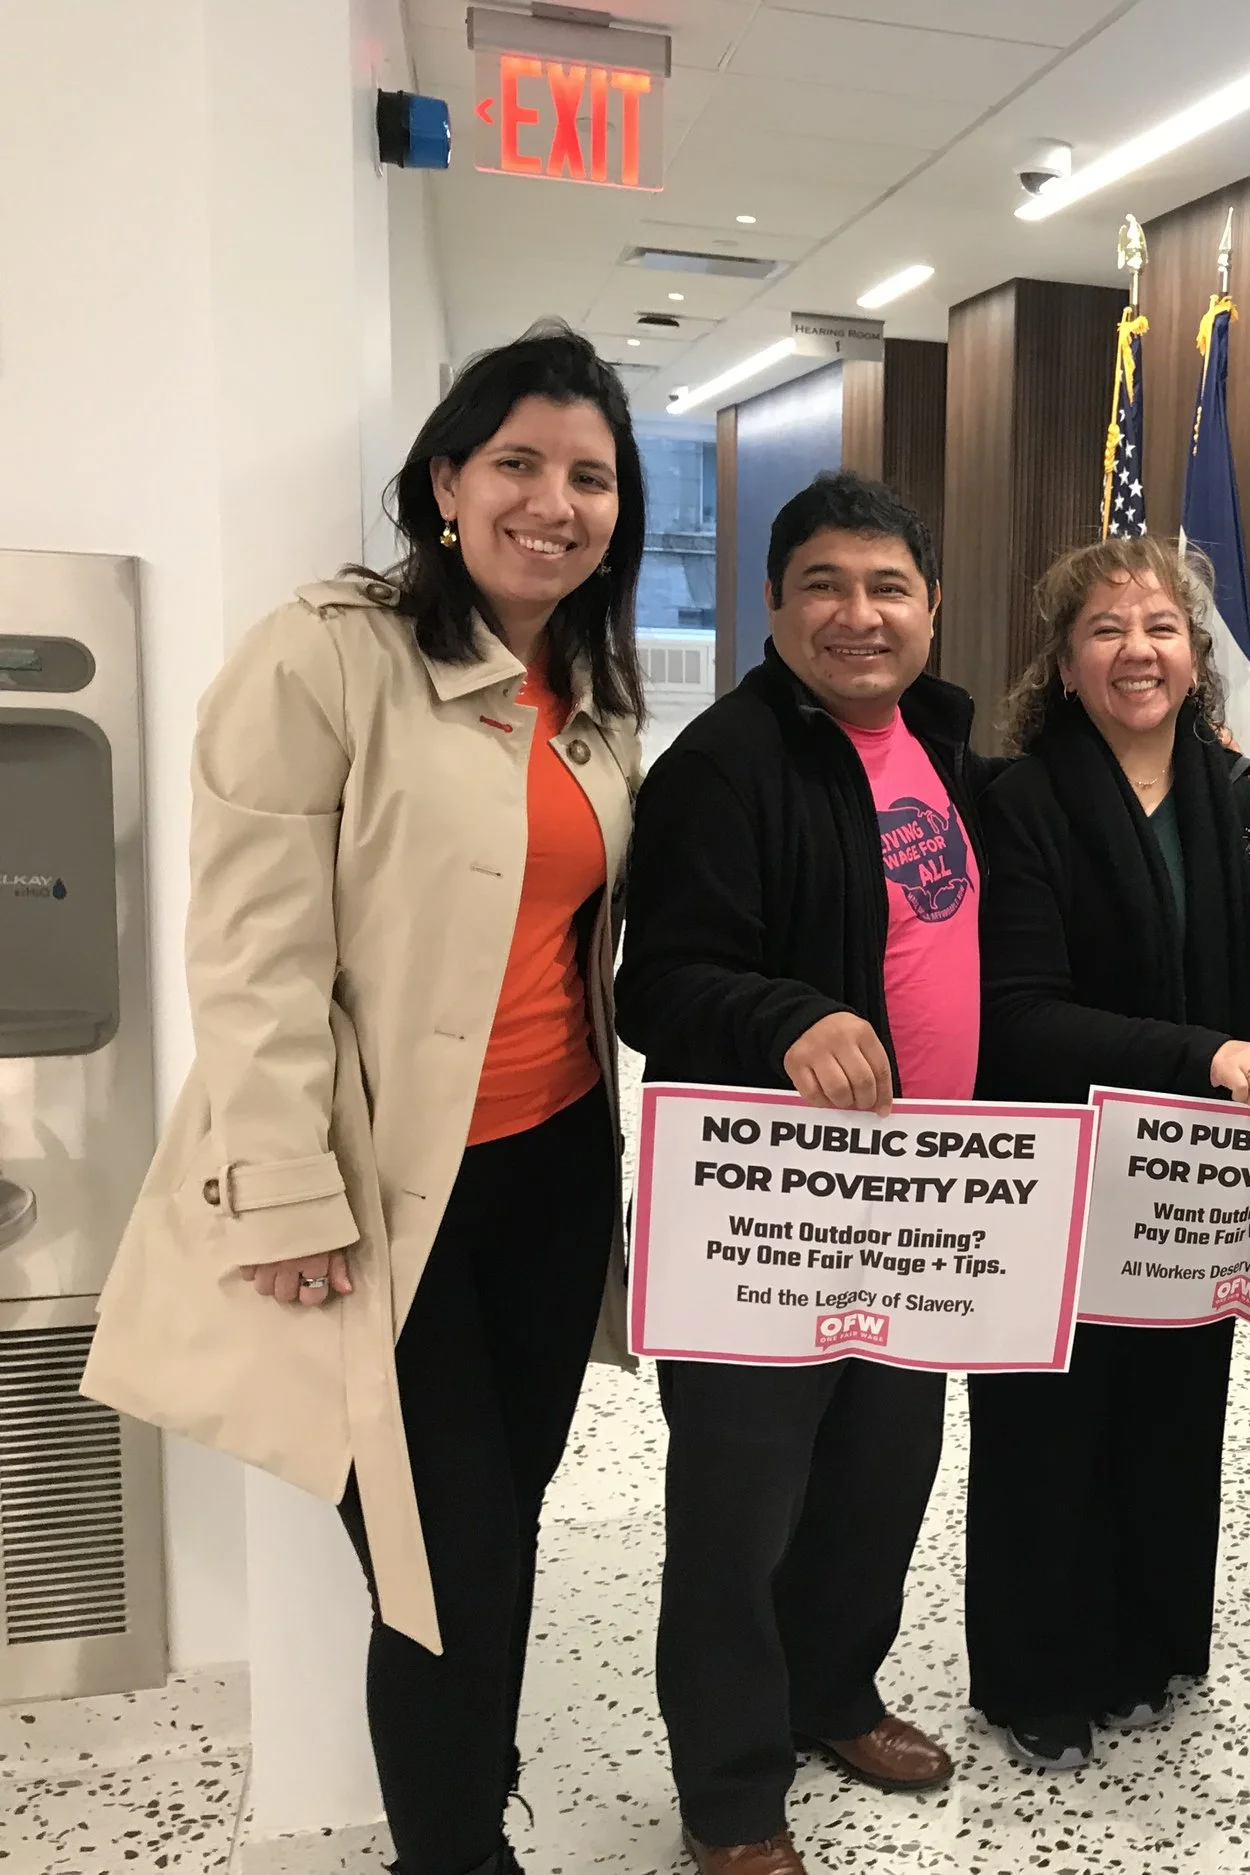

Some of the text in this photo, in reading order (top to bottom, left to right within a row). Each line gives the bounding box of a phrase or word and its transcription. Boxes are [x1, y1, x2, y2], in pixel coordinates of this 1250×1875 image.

[501, 55, 651, 186] EXIT
[835, 340, 841, 353] 1
[883, 835, 947, 871] WAGE FOR
[0, 874, 53, 886] LKAY
[918, 854, 952, 887] ALL
[701, 1115, 1037, 1160] NO PUBLIC SPACE
[1136, 1117, 1184, 1144] NO
[694, 1161, 1039, 1205] FOR POVERTY PAY
[1127, 1155, 1190, 1183] FOR
[1153, 1201, 1205, 1224] Want
[728, 1215, 986, 1253] Want Outdoor Dining?
[1133, 1222, 1171, 1245] Pay
[1174, 1226, 1210, 1245] One
[1214, 1227, 1247, 1246] Fair
[706, 1241, 1006, 1278] Pay One Fair Wage + Tips.
[1120, 1260, 1142, 1276] All
[1145, 1262, 1206, 1281] Workers
[737, 1285, 975, 1316] End the Legacy of Slavery.
[820, 1313, 885, 1337] OFW
[860, 1332, 884, 1342] WAGE
